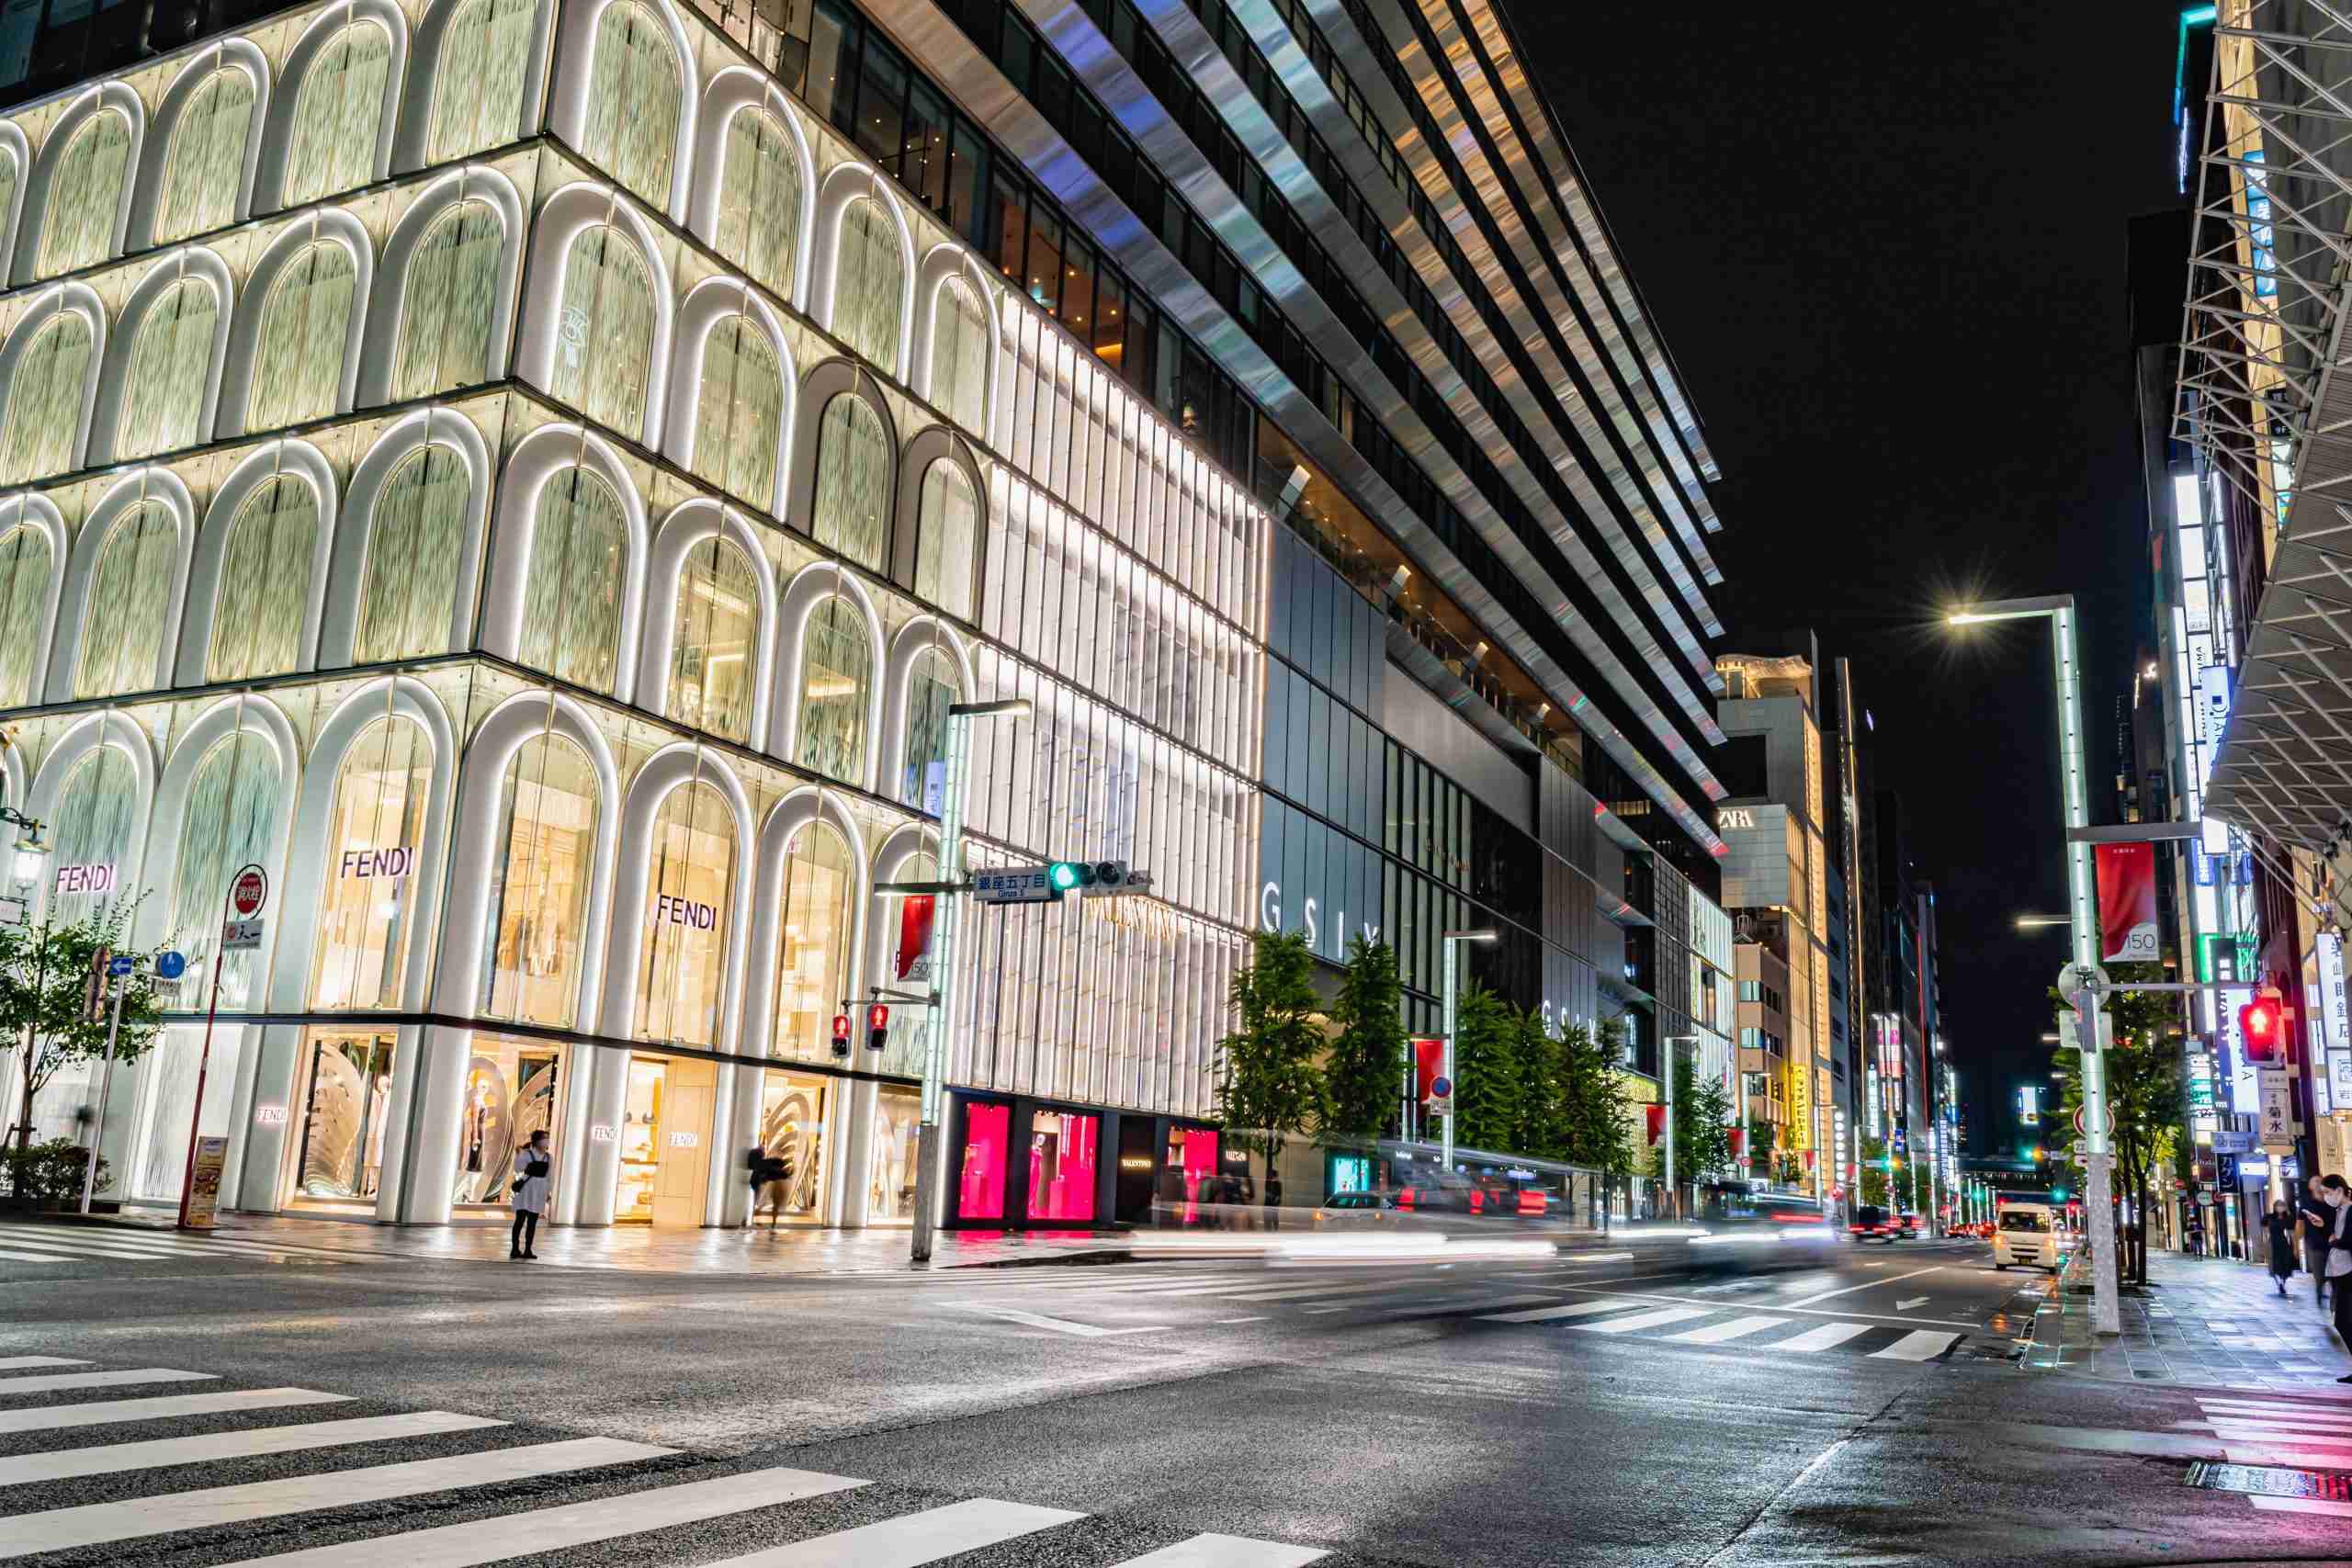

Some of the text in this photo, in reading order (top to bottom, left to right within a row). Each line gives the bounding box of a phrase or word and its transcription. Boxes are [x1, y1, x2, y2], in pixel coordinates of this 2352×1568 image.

[1719, 810, 1754, 828] ZARA
[341, 847, 413, 878] FENDI
[55, 864, 114, 893] FENDI
[978, 874, 1046, 890] 銀座五丁目
[999, 888, 1017, 897] Ginza
[657, 895, 717, 931] FENDI
[2127, 933, 2155, 949] 150
[594, 1126, 618, 1139] FENDI
